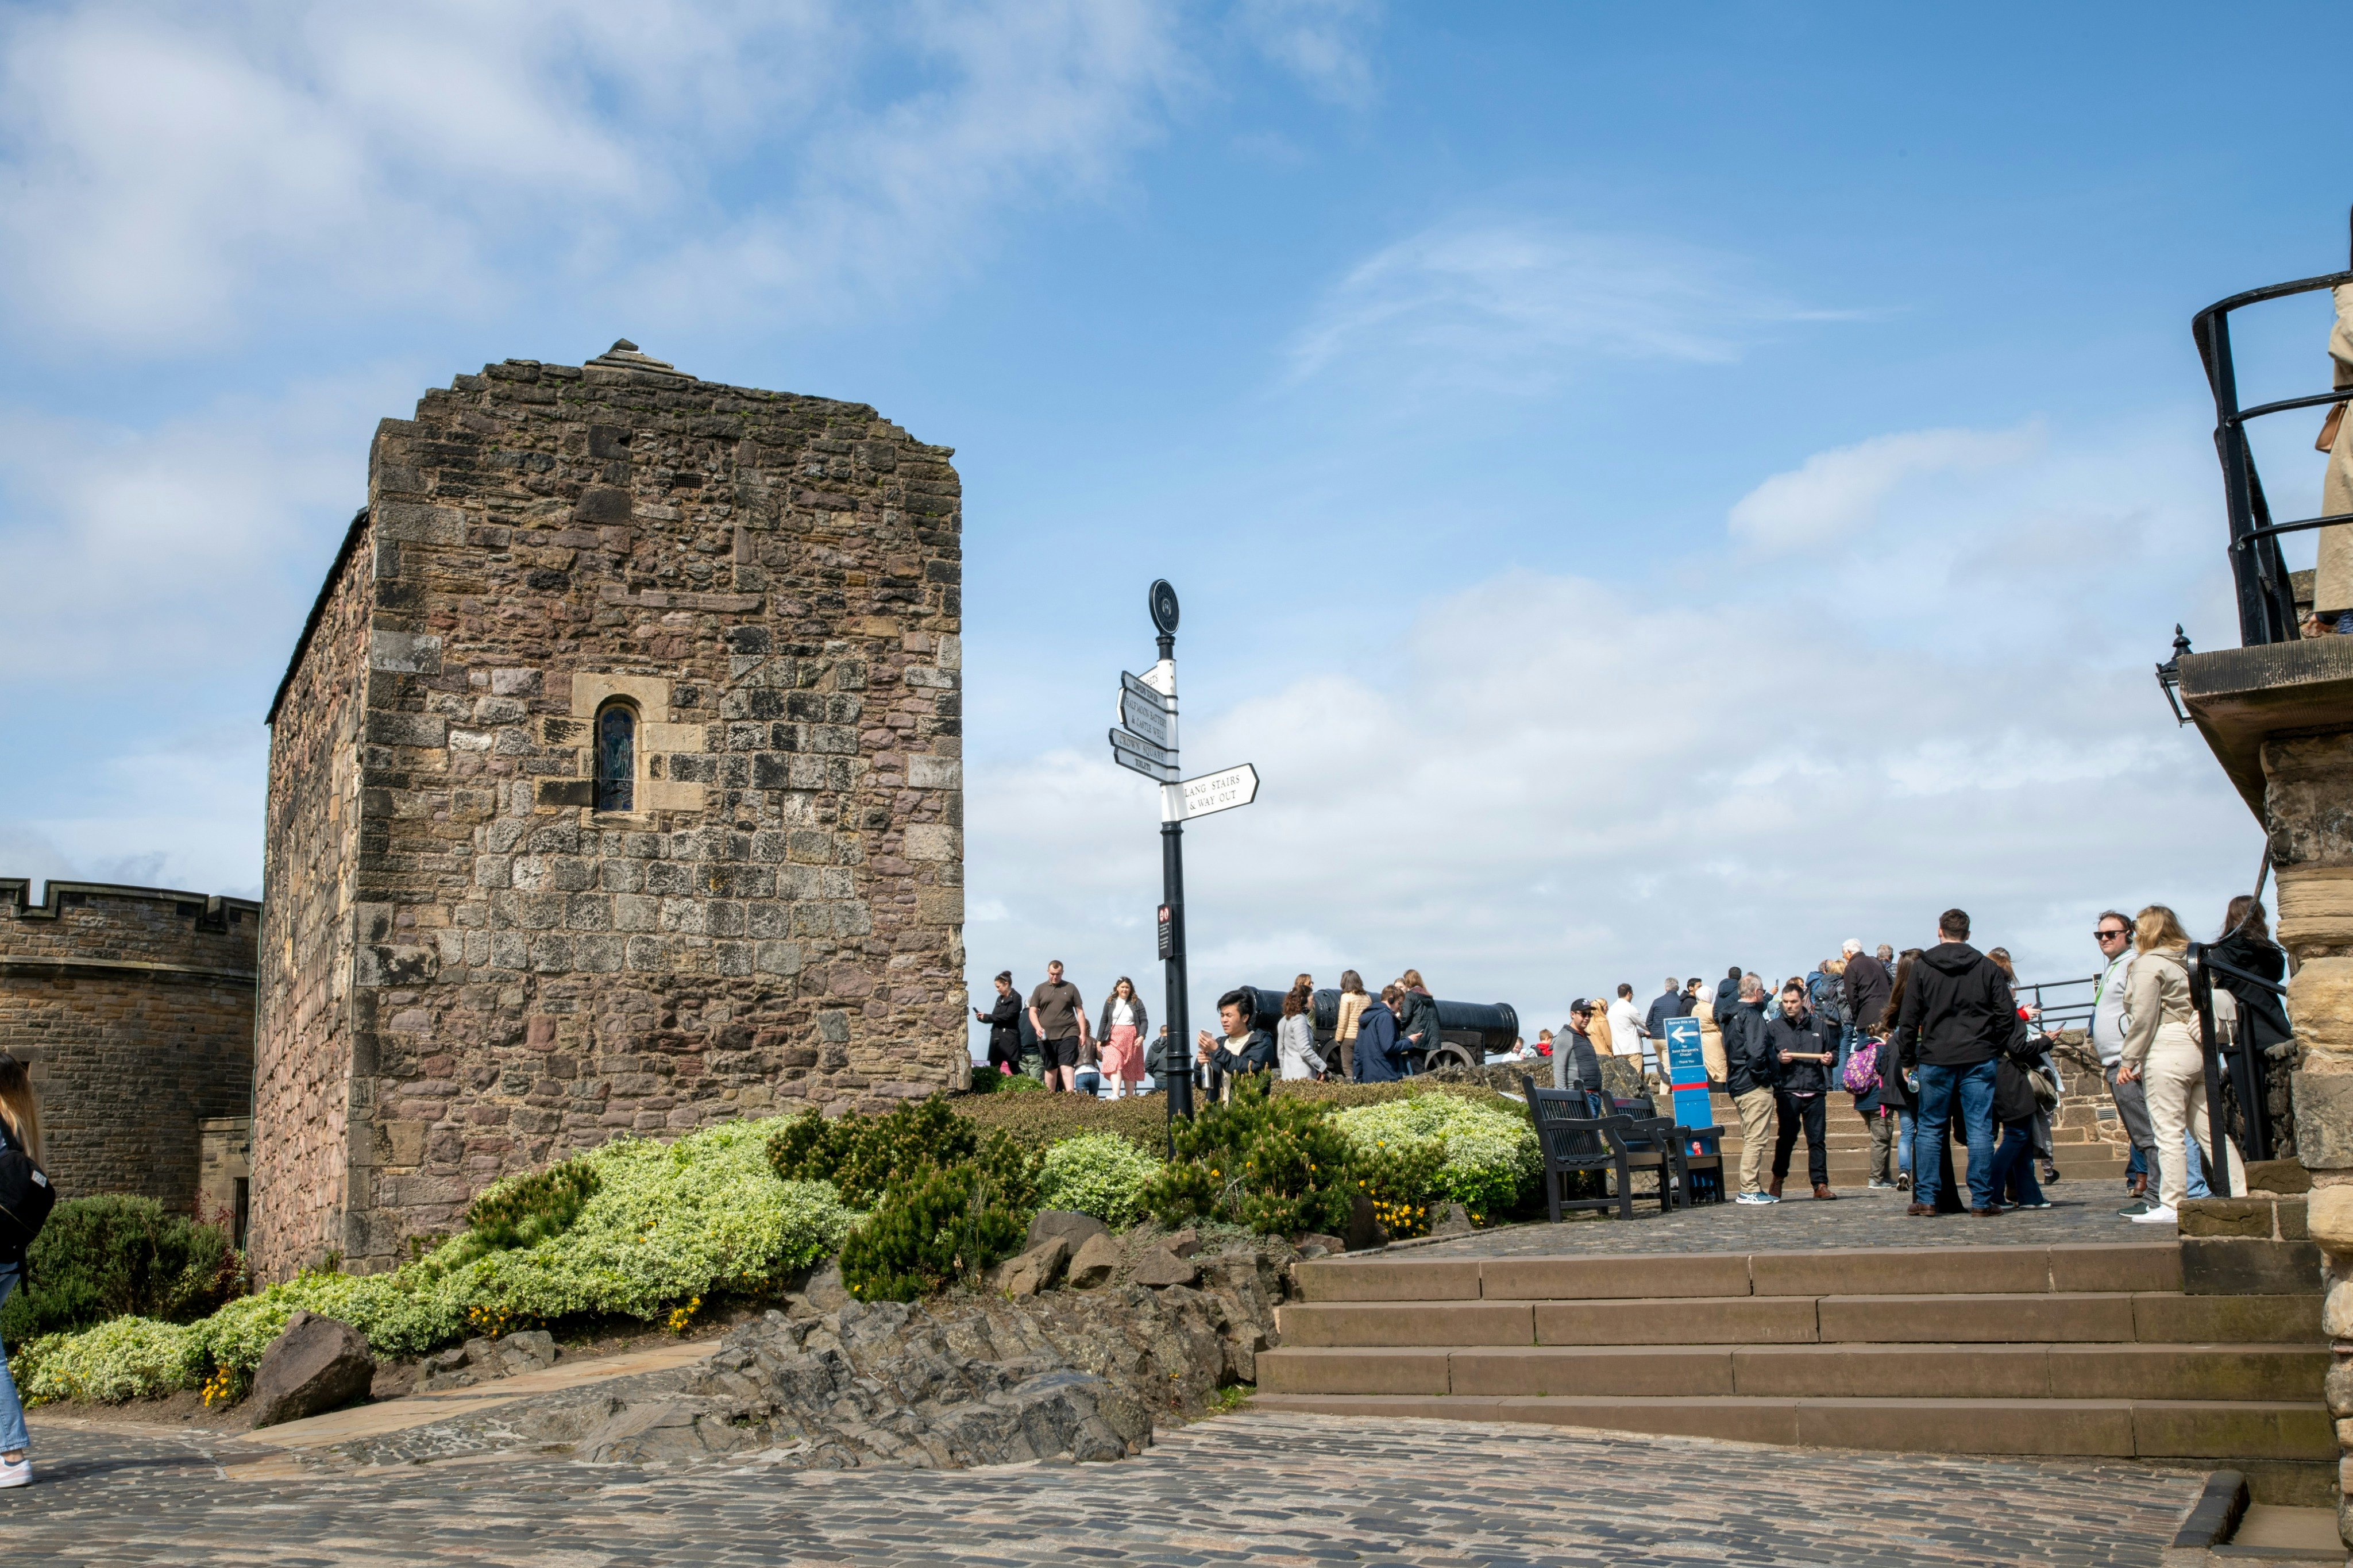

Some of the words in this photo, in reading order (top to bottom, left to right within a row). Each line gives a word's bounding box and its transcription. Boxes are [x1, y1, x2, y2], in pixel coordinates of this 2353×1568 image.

[1132, 715, 1136, 724] &
[1136, 717, 1151, 733] CASTLE
[1153, 726, 1164, 740] WELL
[1150, 711, 1167, 728] BATTERY
[1119, 735, 1140, 751] CROWN
[1143, 745, 1164, 761] SQUARE
[1135, 758, 1151, 771] TOILETS
[1185, 784, 1206, 798] LANG
[1212, 774, 1240, 790] STAIRS
[1189, 801, 1195, 810] &
[1198, 795, 1215, 808] WAY
[1219, 790, 1236, 802] OUT
